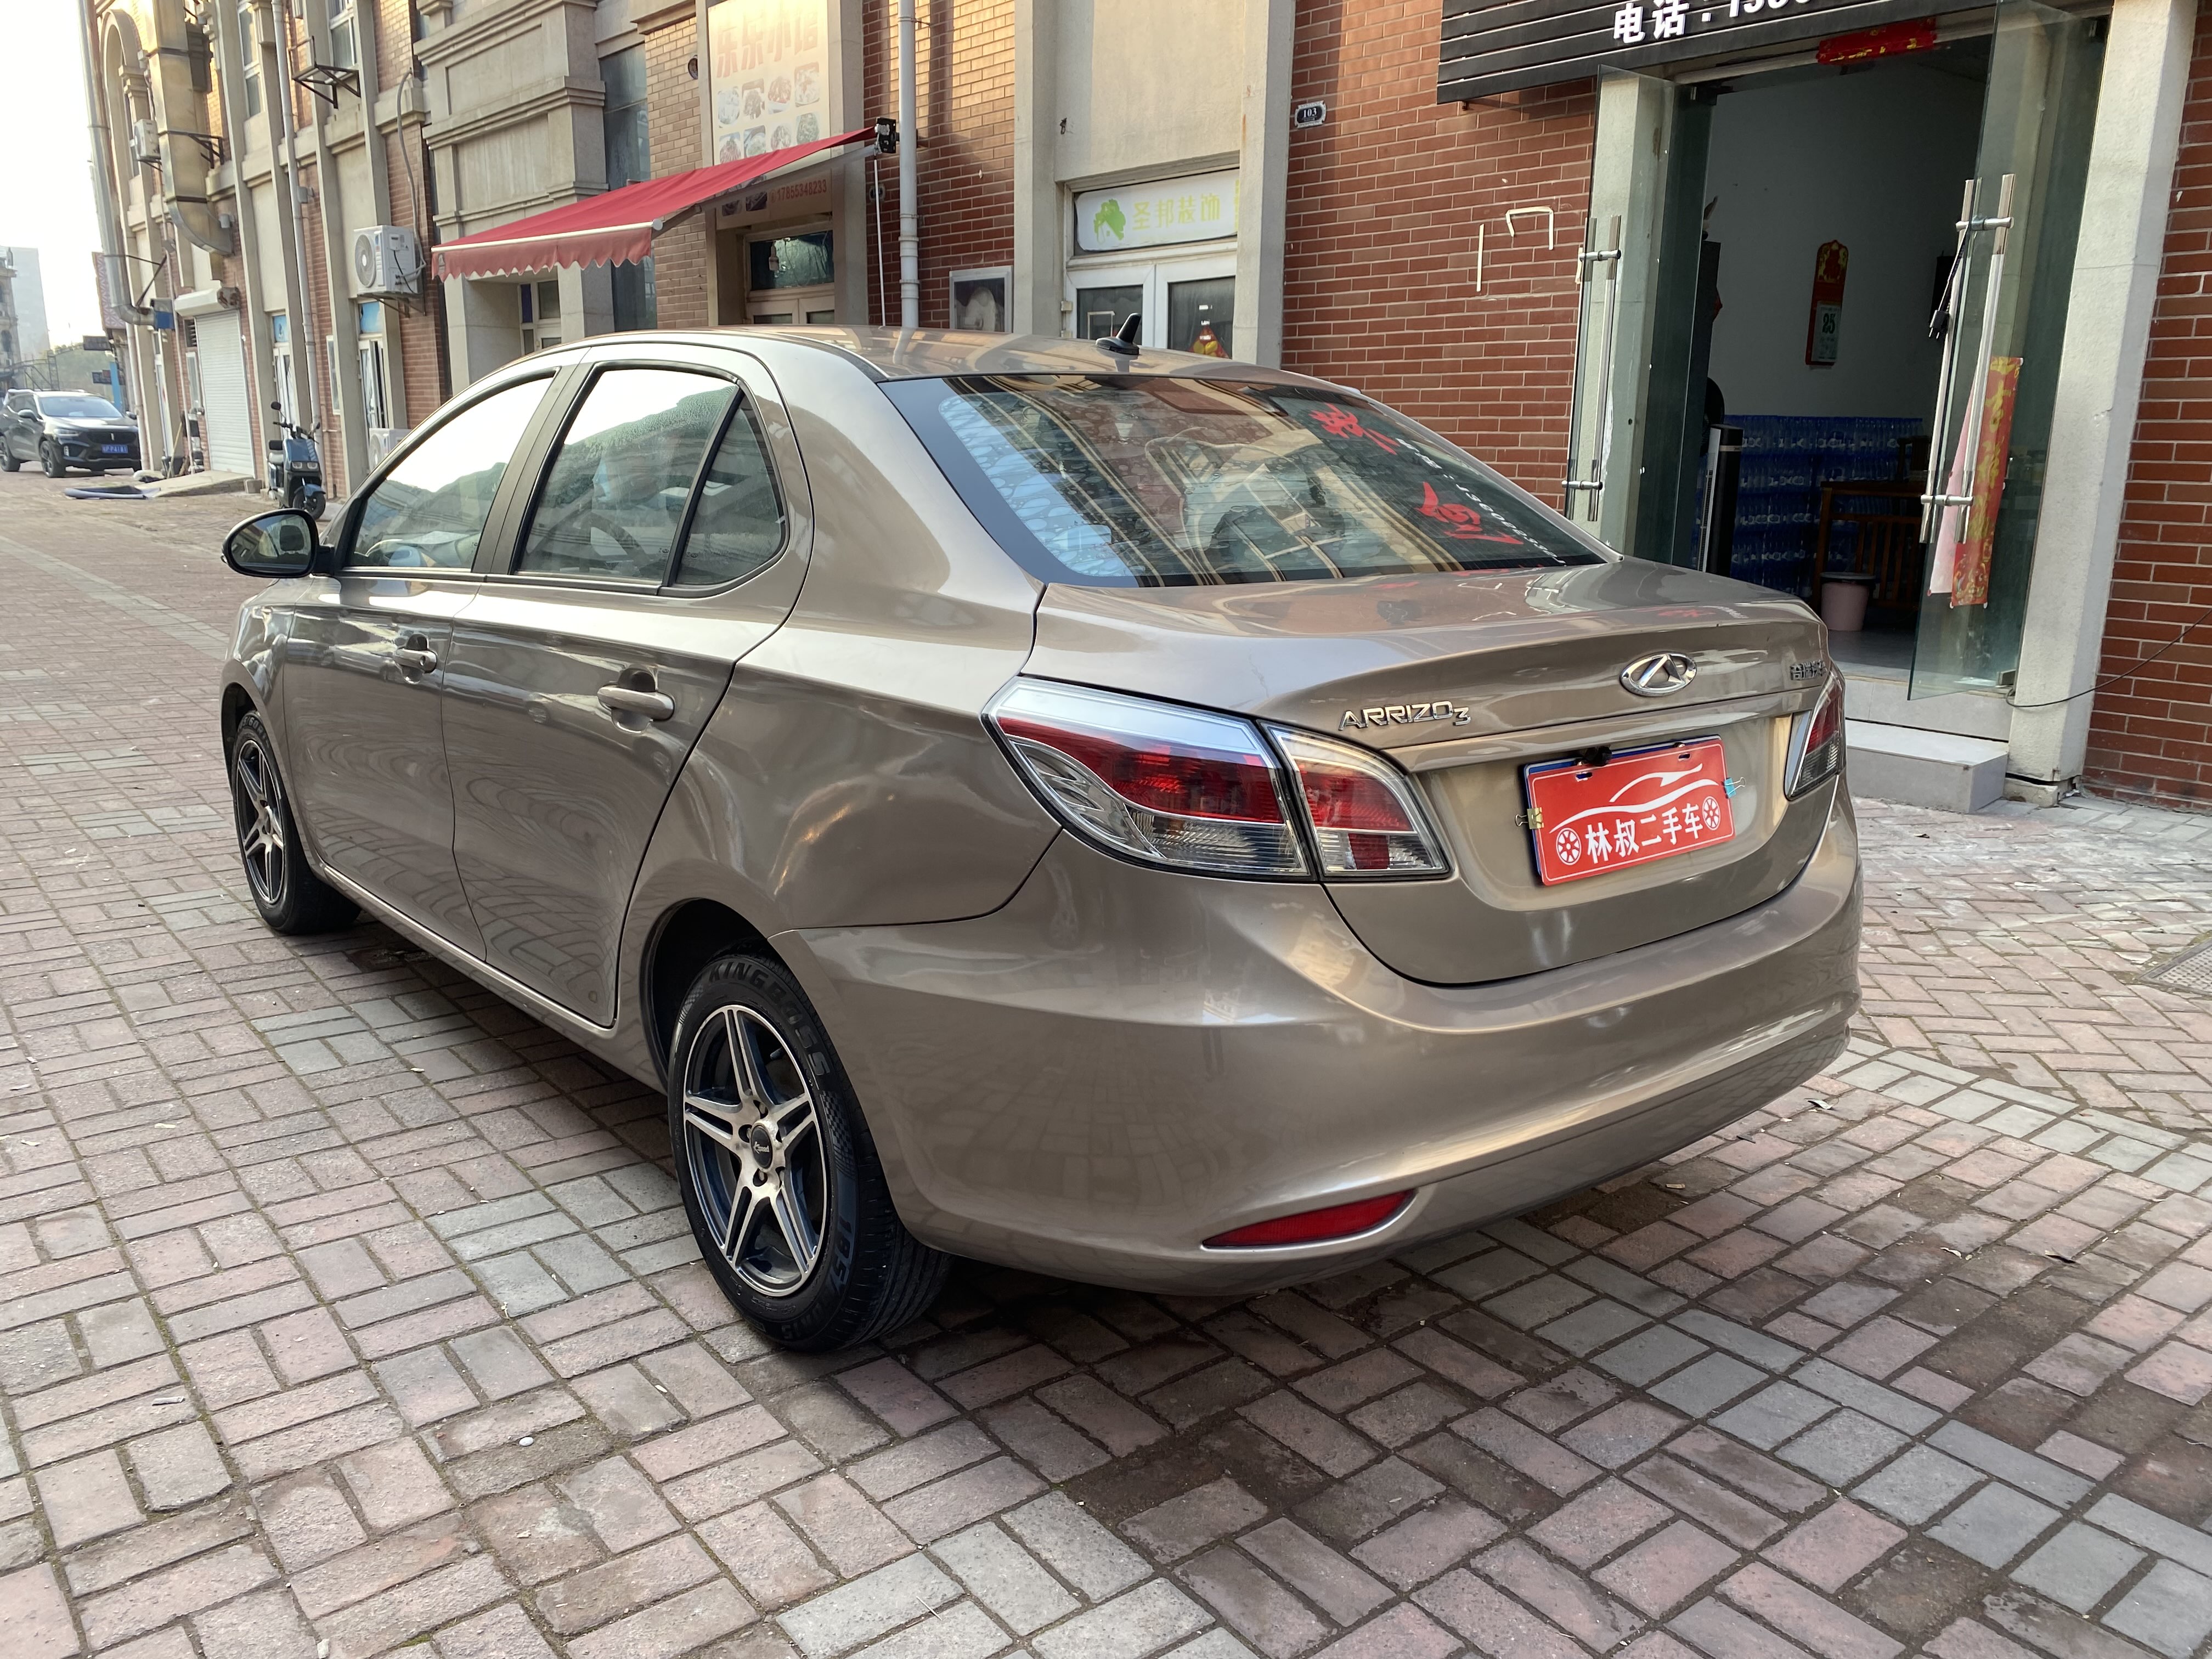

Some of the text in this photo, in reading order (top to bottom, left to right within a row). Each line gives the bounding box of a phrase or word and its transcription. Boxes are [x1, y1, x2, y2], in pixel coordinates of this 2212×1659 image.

[1303, 107, 1317, 118] 103
[1132, 193, 1221, 230] 圣邦装饰
[1822, 313, 1836, 334] 25
[1585, 802, 1704, 865] 林叔二手车
[708, 961, 831, 1076] KINGBOSS
